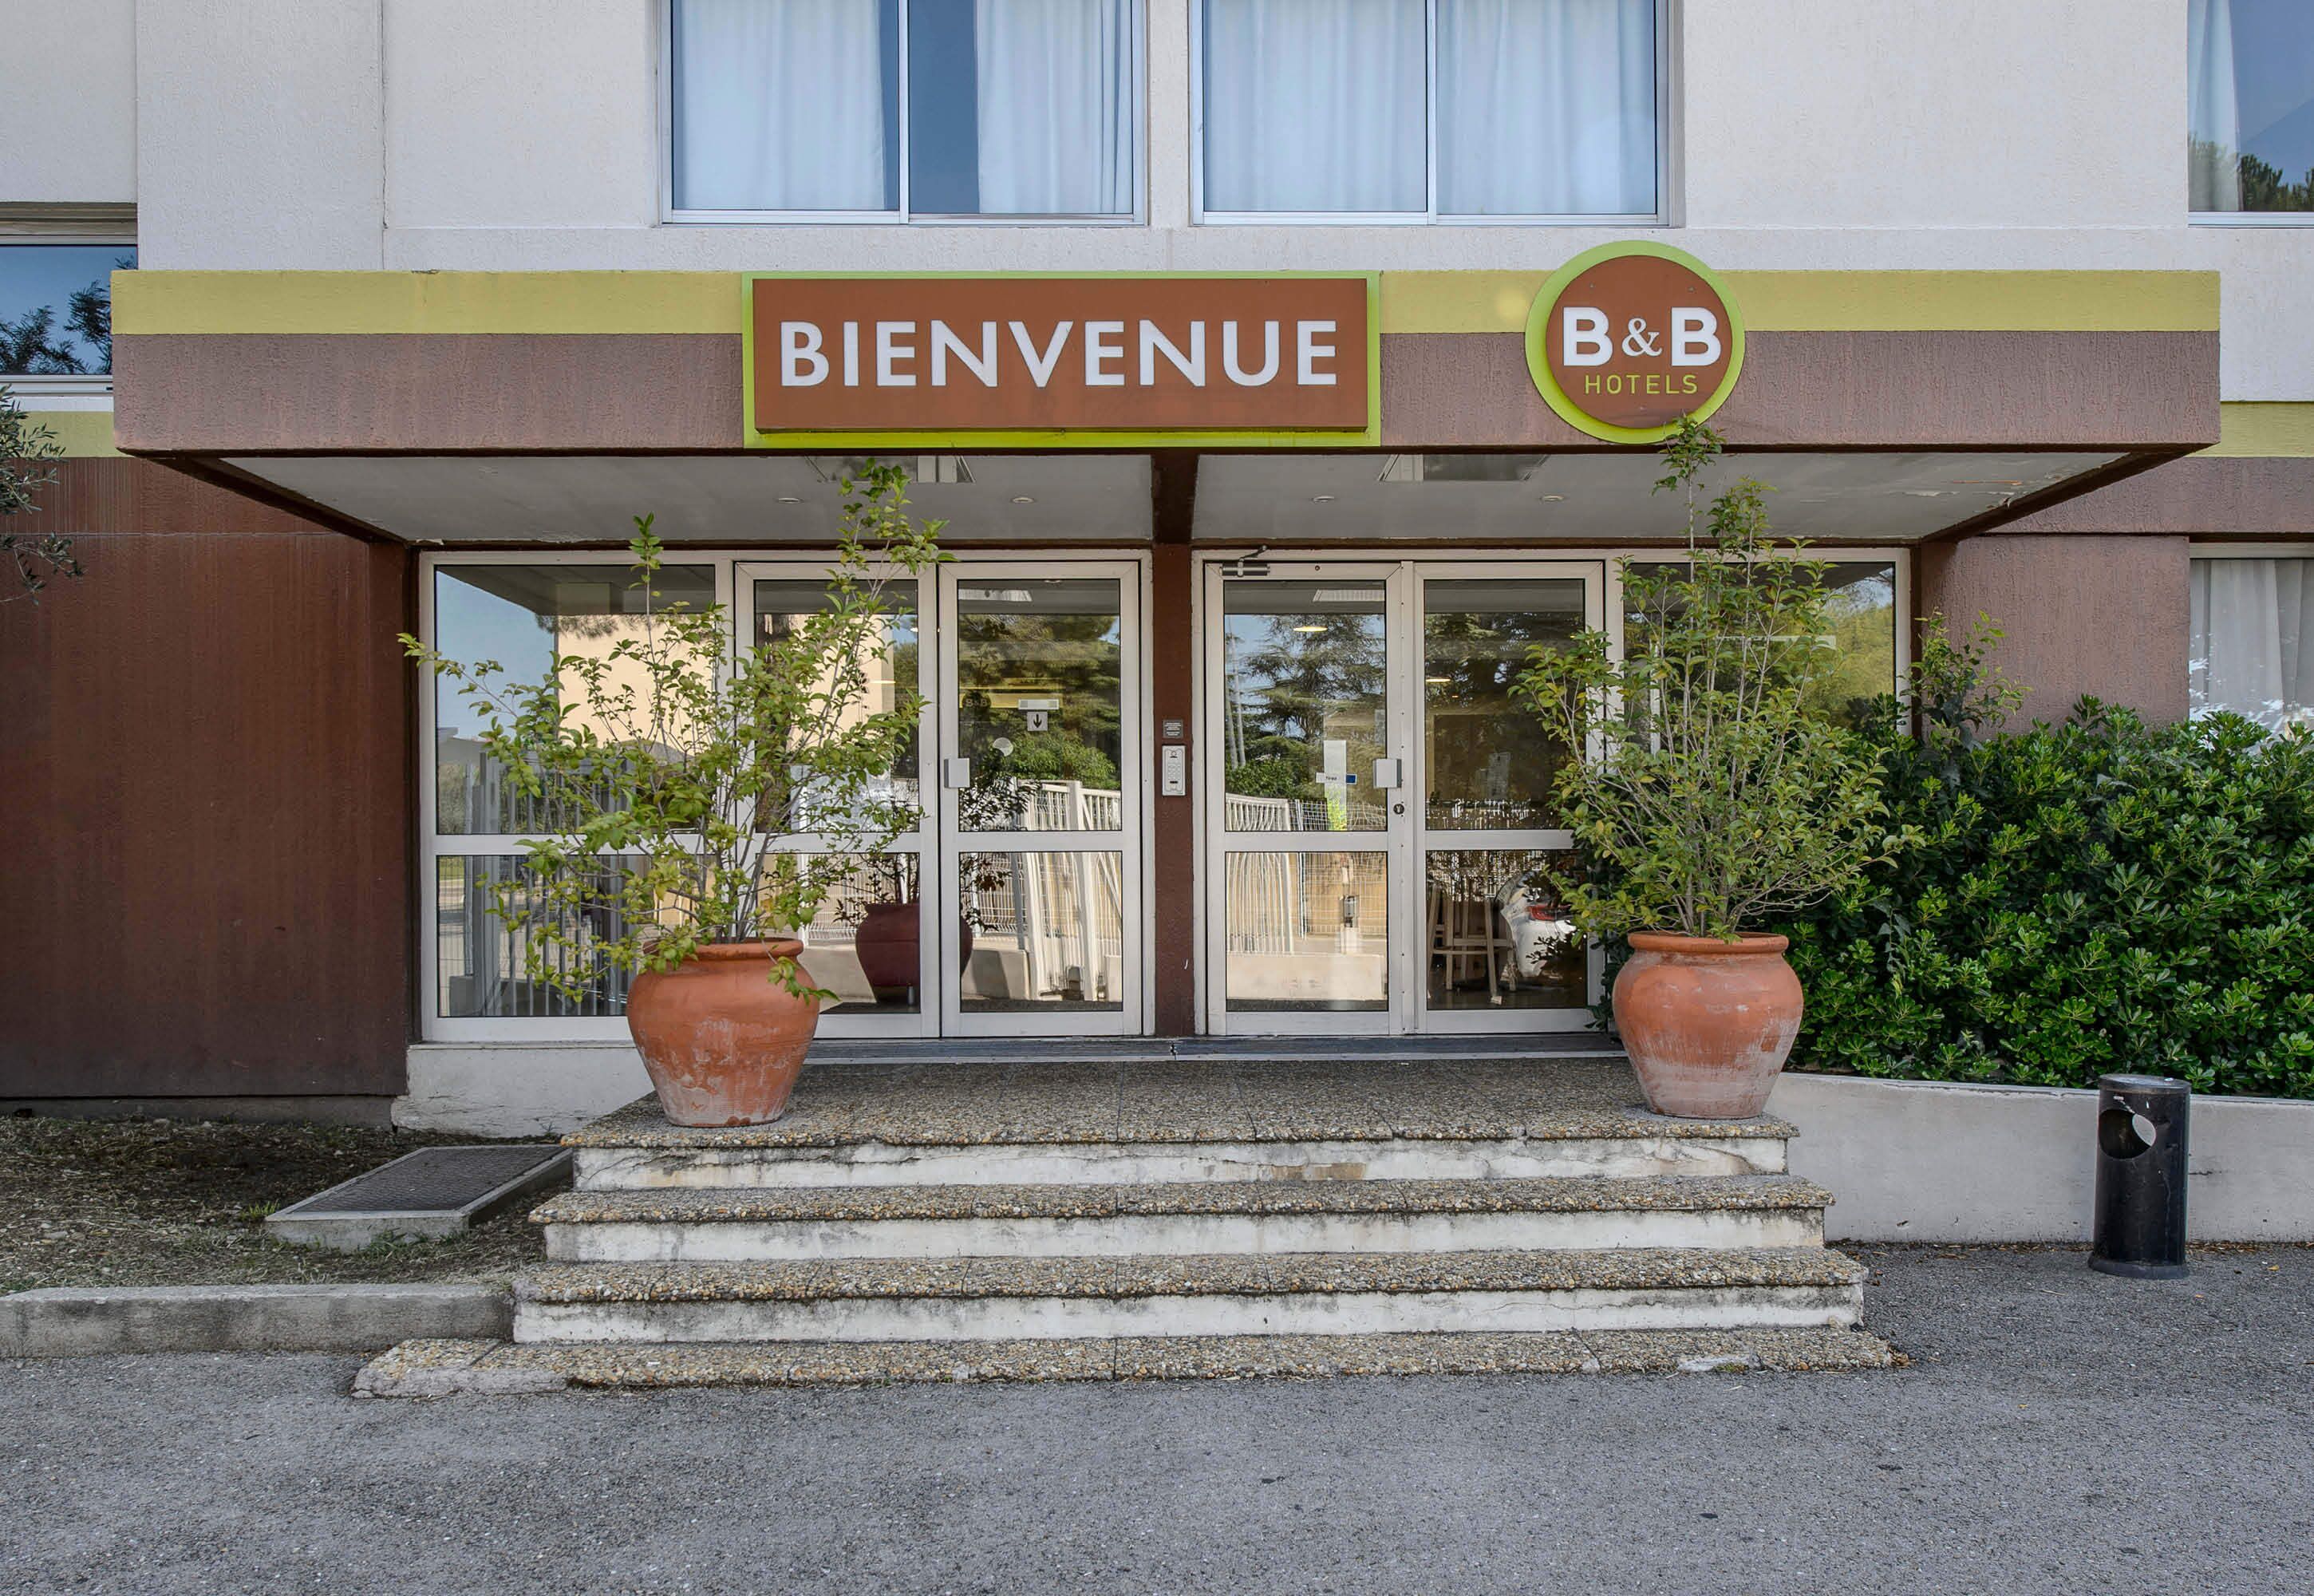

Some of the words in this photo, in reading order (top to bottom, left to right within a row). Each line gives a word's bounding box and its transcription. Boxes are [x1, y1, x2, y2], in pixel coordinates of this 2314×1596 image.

[780, 319, 1337, 388] BIENVENUE
[1563, 306, 1721, 366] B&B
[1585, 374, 1698, 395] HOTELS
